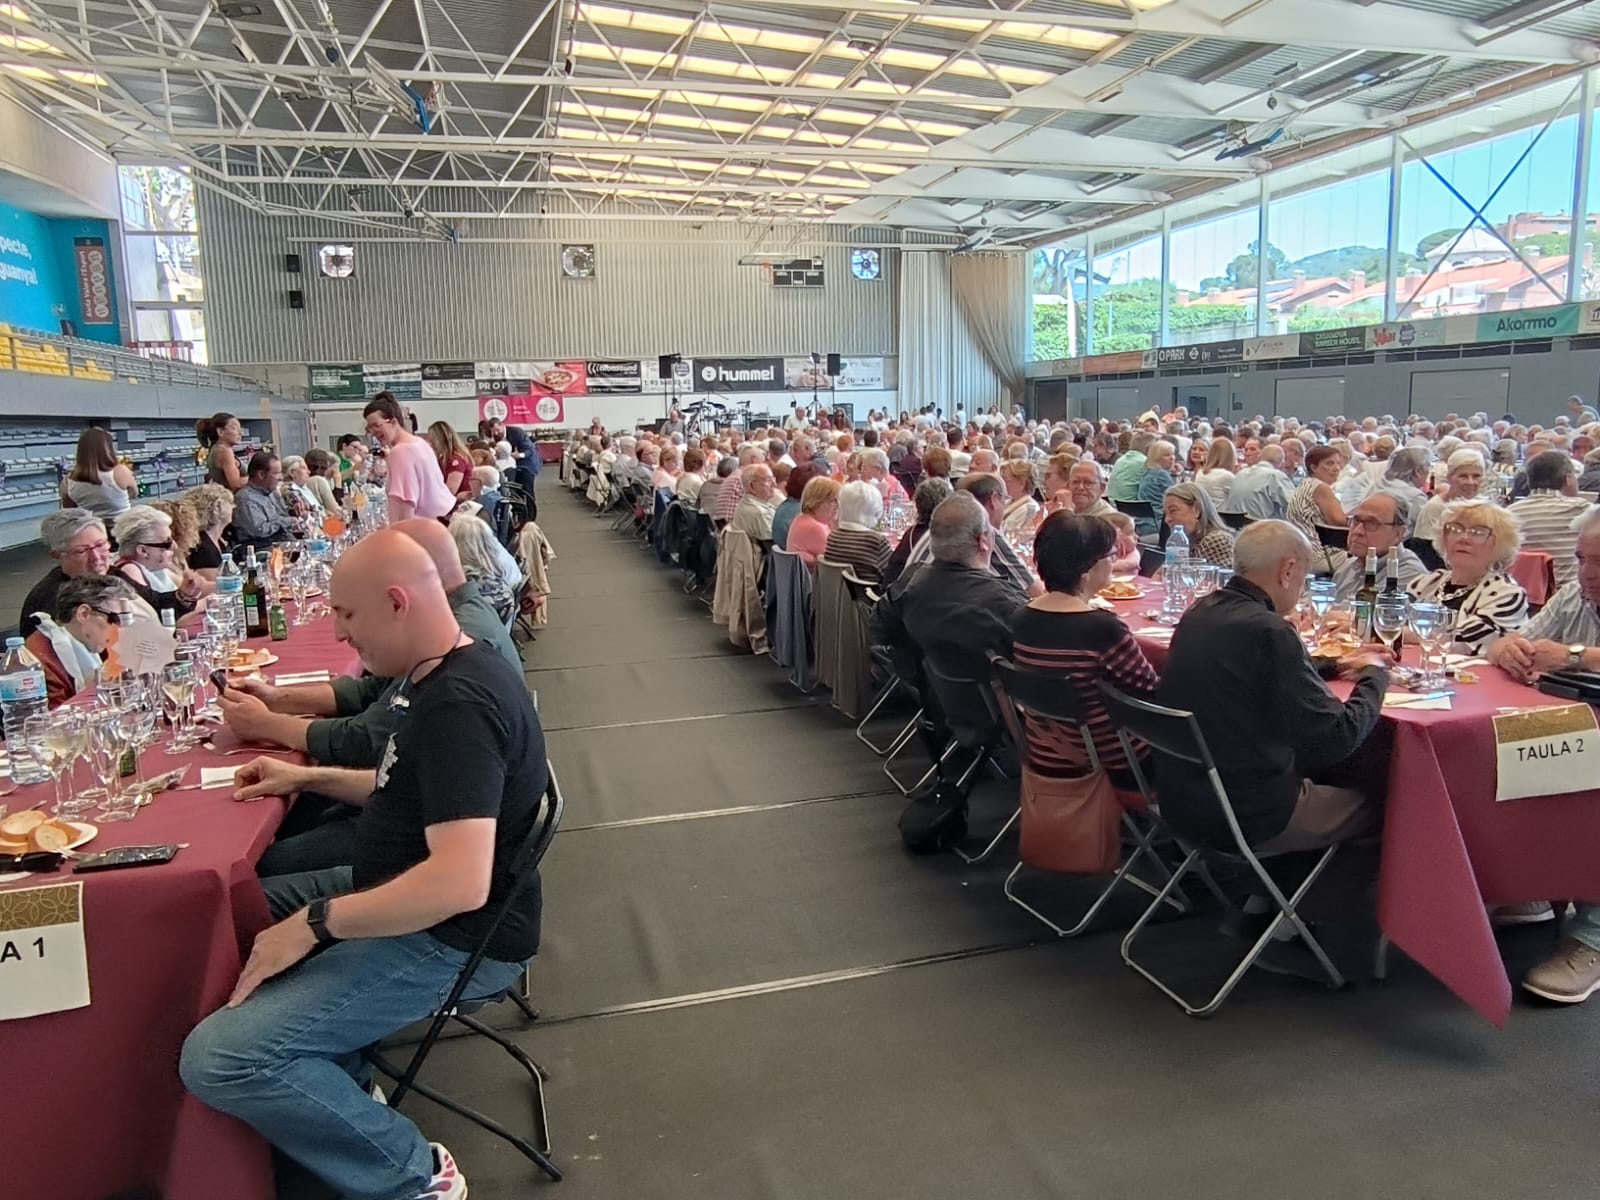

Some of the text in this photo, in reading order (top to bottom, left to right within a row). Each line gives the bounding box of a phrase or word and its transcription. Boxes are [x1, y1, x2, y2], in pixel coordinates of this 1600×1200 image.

[718, 365, 775, 381] hummel
[1516, 738, 1585, 762] TAULA 2
[33, 936, 45, 958] 1
